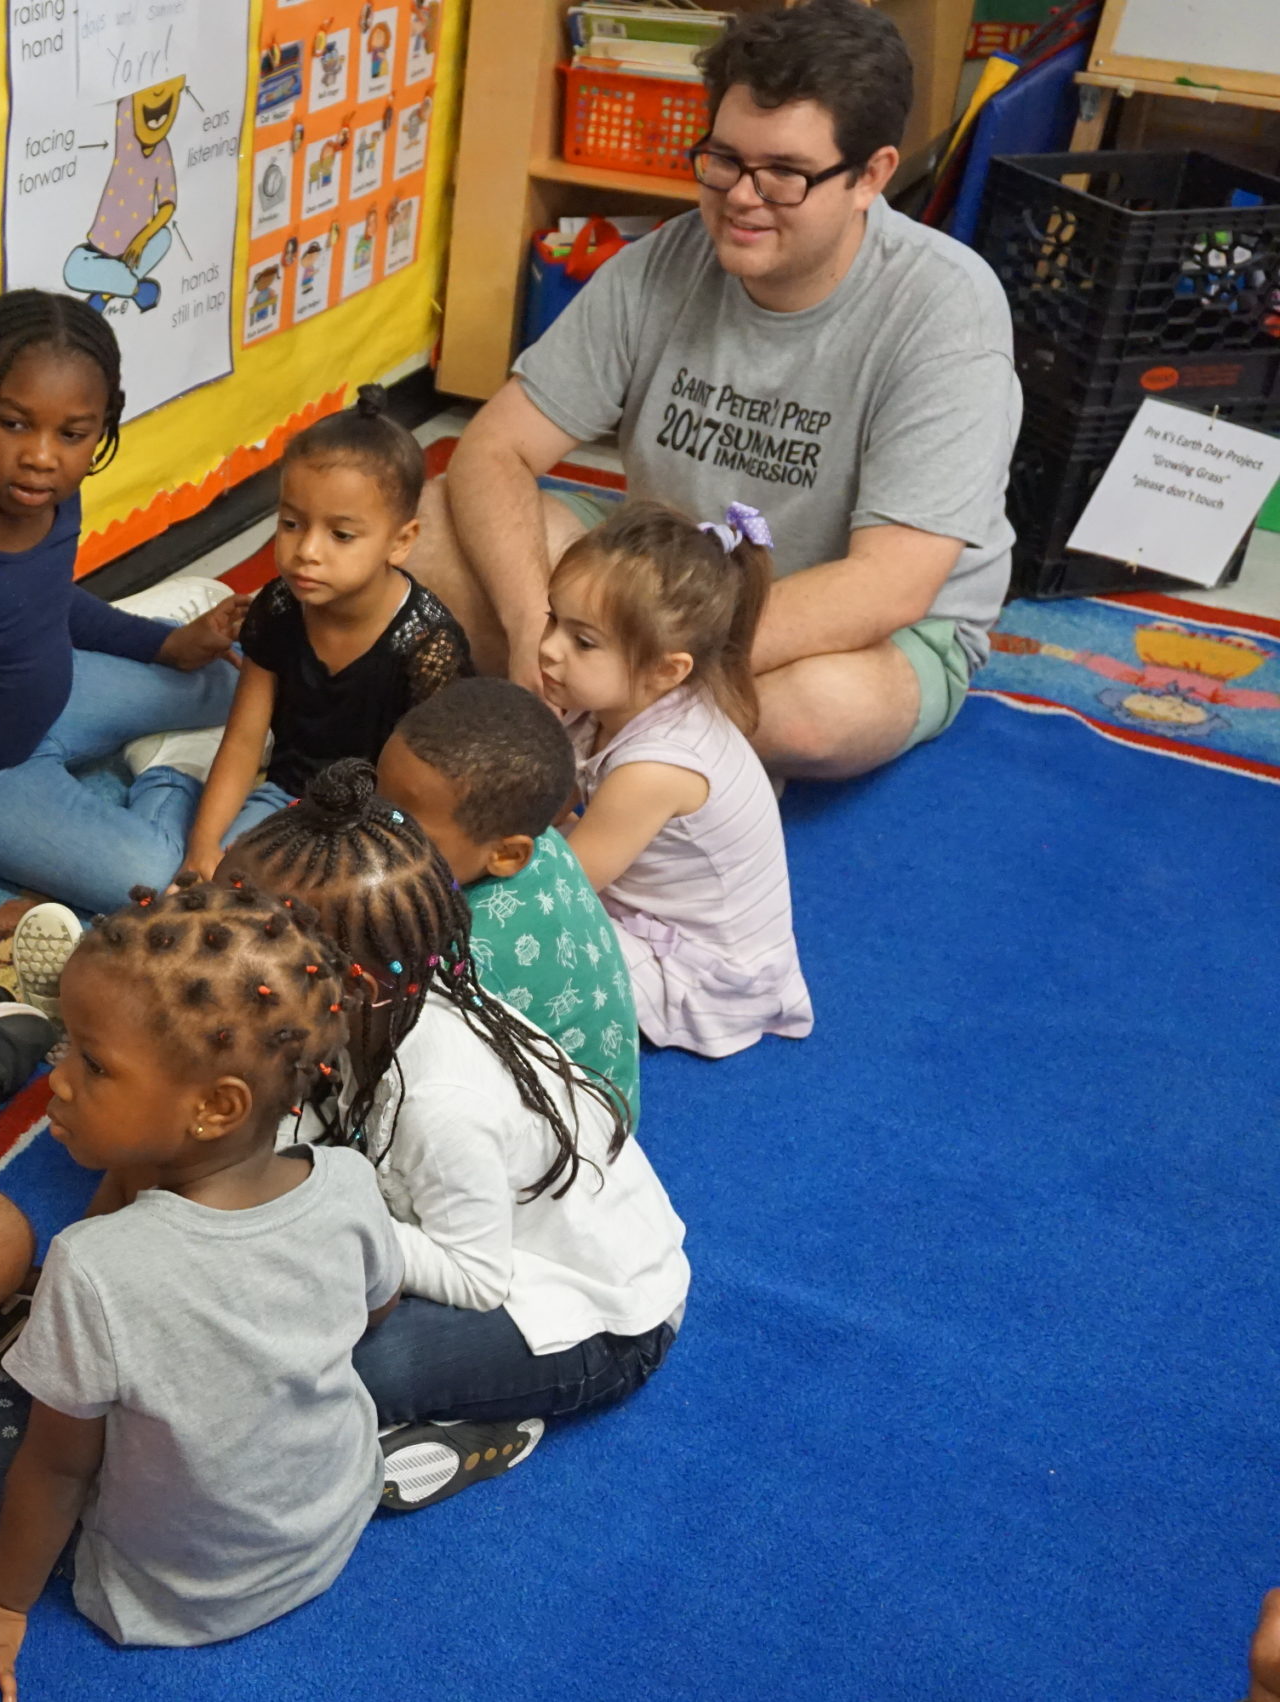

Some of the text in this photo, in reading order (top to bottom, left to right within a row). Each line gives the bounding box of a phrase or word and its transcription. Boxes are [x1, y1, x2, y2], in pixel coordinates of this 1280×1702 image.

[14, 0, 65, 25] raising
[22, 29, 64, 62] hand
[202, 109, 230, 132] ears
[25, 129, 75, 159] facing
[186, 136, 239, 168] listening
[18, 156, 78, 195] forward
[181, 263, 220, 294] hands
[171, 291, 226, 328] still in lap
[671, 367, 716, 407] SAINT
[781, 401, 832, 435] PREP
[656, 403, 721, 462] 2017
[718, 423, 821, 468] SUMMER
[1144, 426, 1161, 438] Pre
[1176, 435, 1202, 452] Earth
[1203, 443, 1224, 459] Day
[1225, 450, 1264, 471] Project
[713, 447, 817, 489] IMMERSION
[1166, 484, 1195, 501] don't
[1195, 493, 1225, 510] touch
